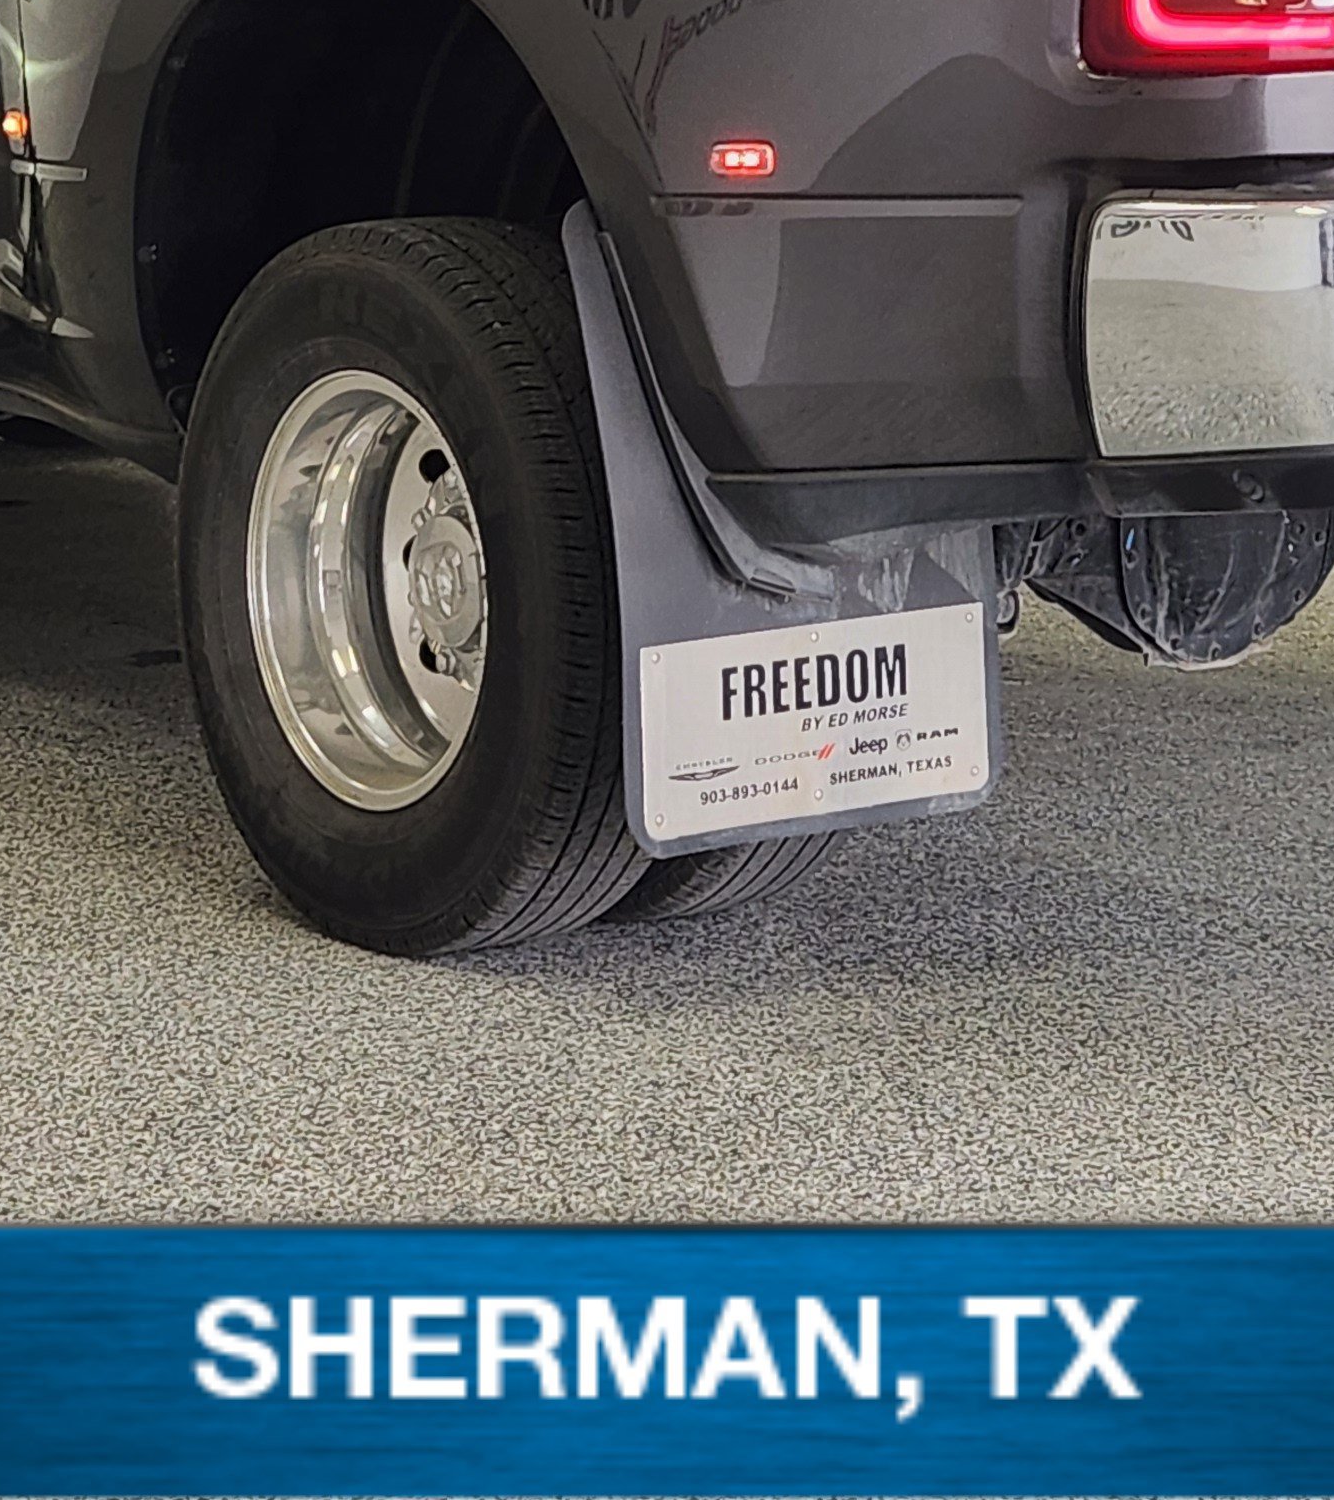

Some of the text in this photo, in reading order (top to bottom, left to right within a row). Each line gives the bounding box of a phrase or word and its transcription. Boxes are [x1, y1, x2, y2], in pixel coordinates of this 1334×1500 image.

[721, 643, 907, 721] FREEDOM
[801, 703, 909, 732] BY ED MORSE
[849, 737, 889, 755] Jeep
[829, 755, 952, 786] SHERMAN, TEXAS
[700, 777, 798, 806] 903-893-0144
